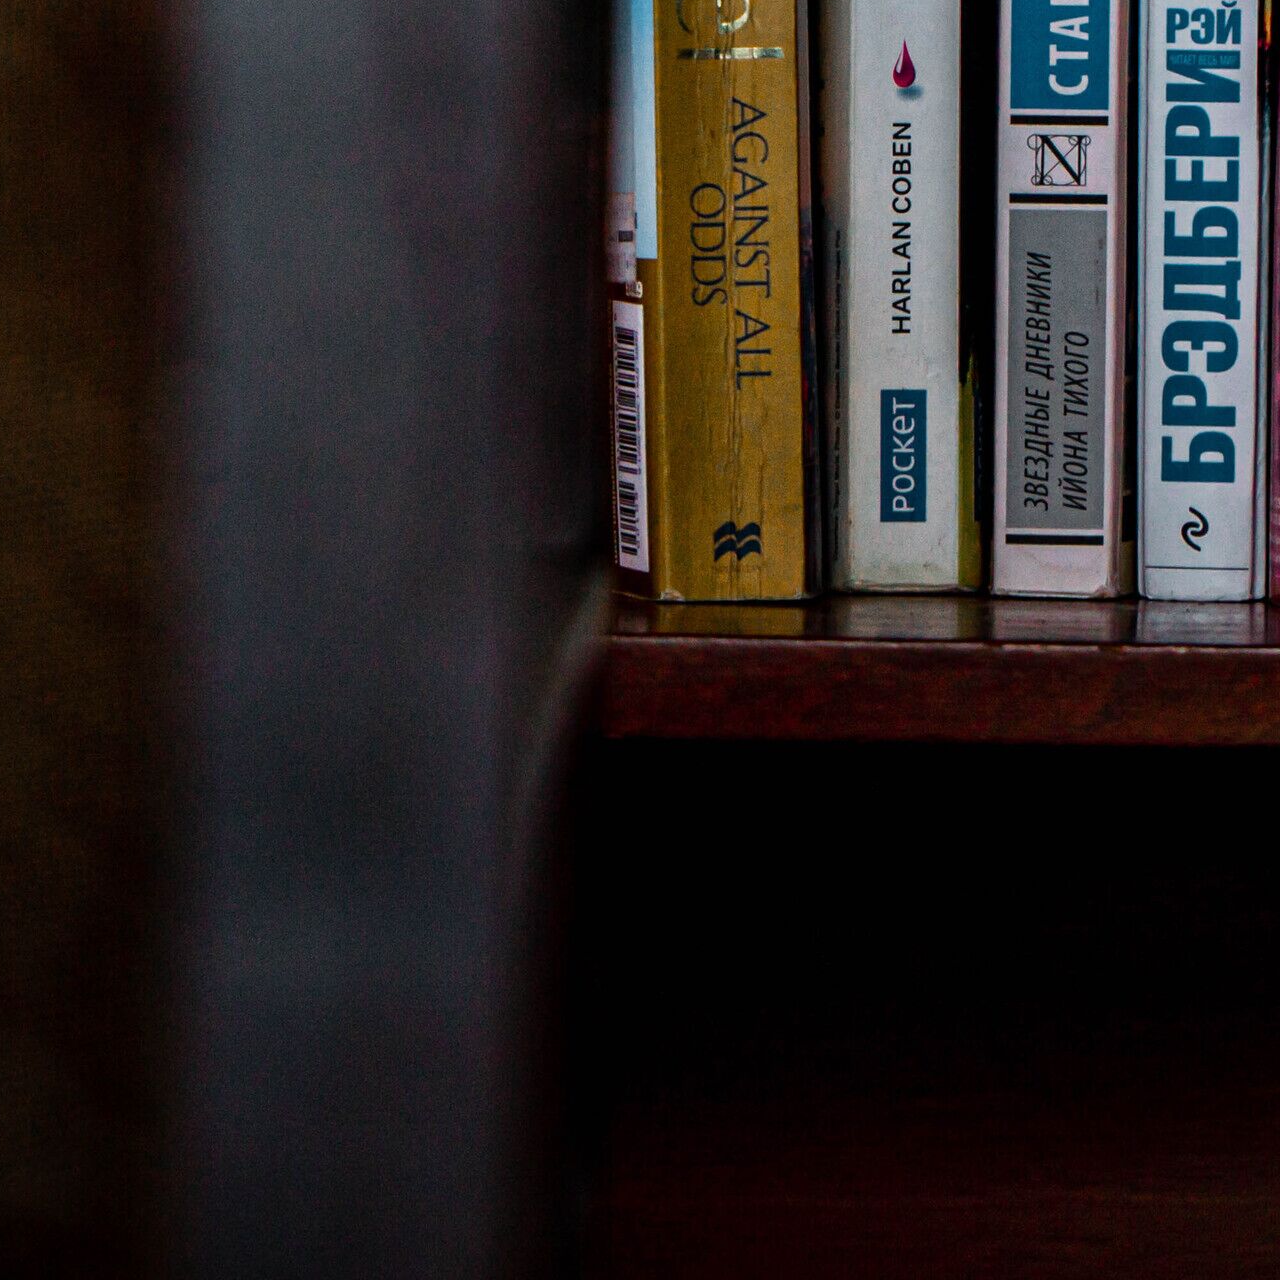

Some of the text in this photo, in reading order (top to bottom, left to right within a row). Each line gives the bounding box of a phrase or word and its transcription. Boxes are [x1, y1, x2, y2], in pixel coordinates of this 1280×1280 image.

[1166, 0, 1242, 45] РЭЙ
[689, 183, 728, 307] ODDS
[732, 96, 773, 391] AGAINST ALL
[892, 122, 912, 335] HARLAN COBEN
[1161, 49, 1242, 484] БРЭДБЕРИ
[1024, 252, 1057, 512] ЗВЕЗДНЫЕ ДНЕВНИКИ
[1058, 330, 1091, 512] ИЙОНА ТИХОГО
